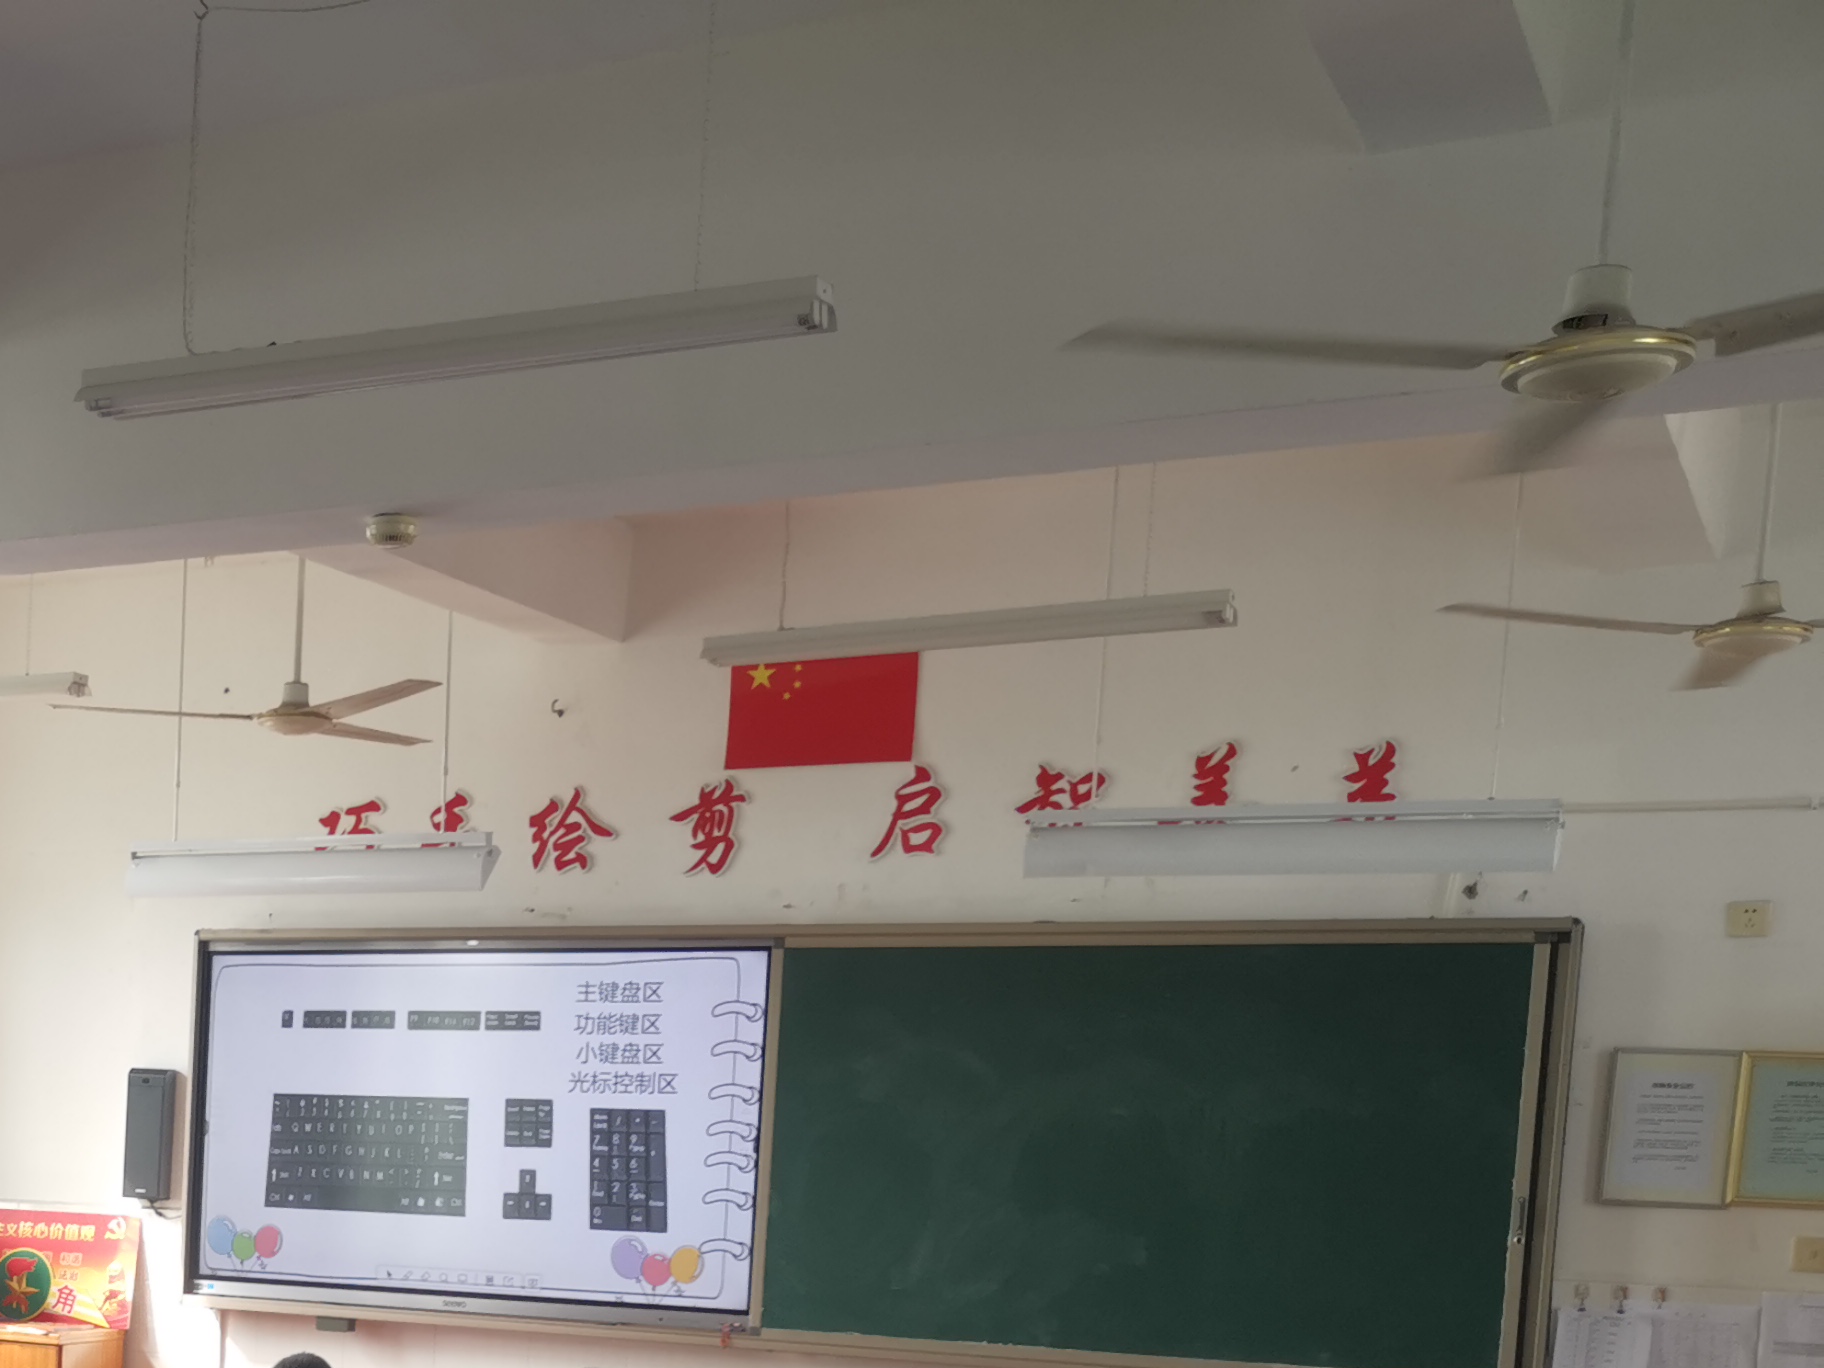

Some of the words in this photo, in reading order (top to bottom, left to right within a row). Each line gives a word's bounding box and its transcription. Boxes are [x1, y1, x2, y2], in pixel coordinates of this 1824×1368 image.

[575, 980, 664, 1003] 主键盘区
[574, 1012, 662, 1035] 功能键区
[576, 1042, 664, 1065] 小键盘区
[568, 1071, 678, 1095] 光标控制区
[52, 1285, 77, 1315] 角
